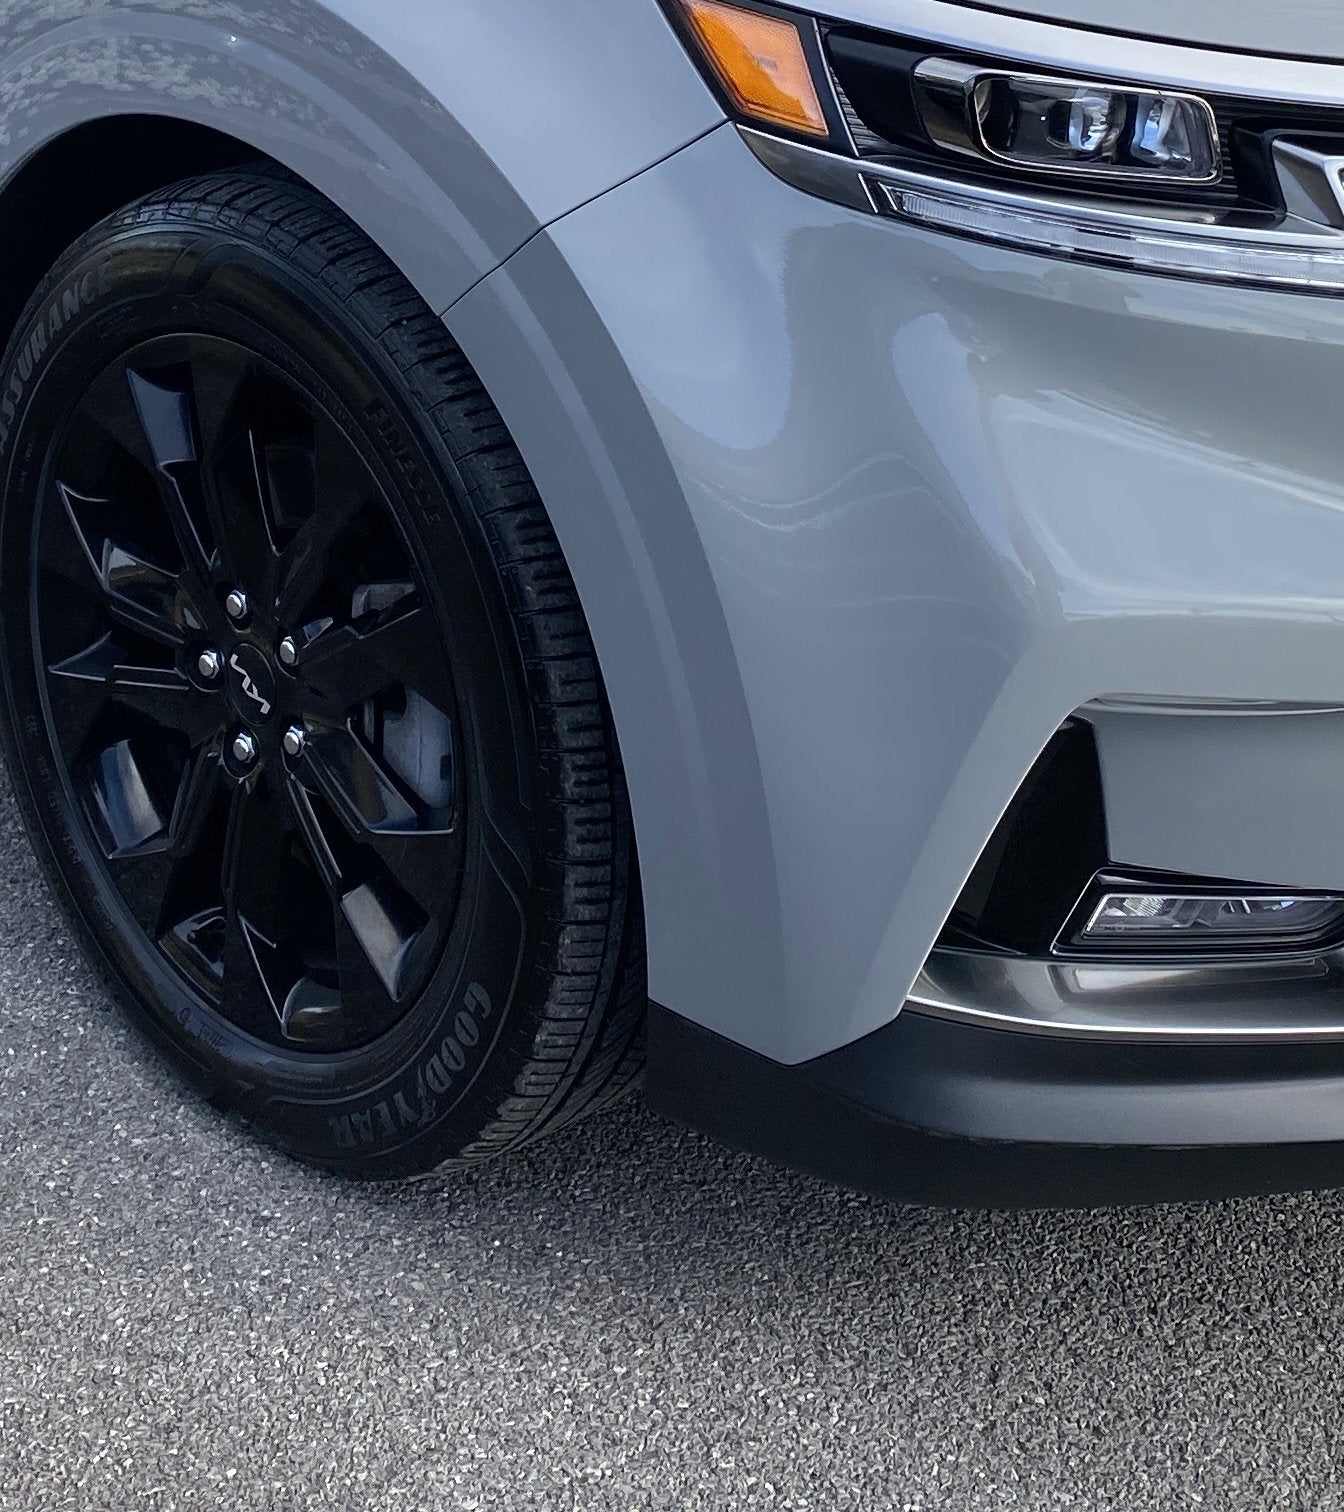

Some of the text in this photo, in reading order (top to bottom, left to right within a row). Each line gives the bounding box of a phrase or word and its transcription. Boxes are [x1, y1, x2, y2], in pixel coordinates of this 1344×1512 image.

[362, 400, 443, 526] FINESSE
[230, 653, 271, 714] KIA
[328, 981, 492, 1149] GOODYEAR
